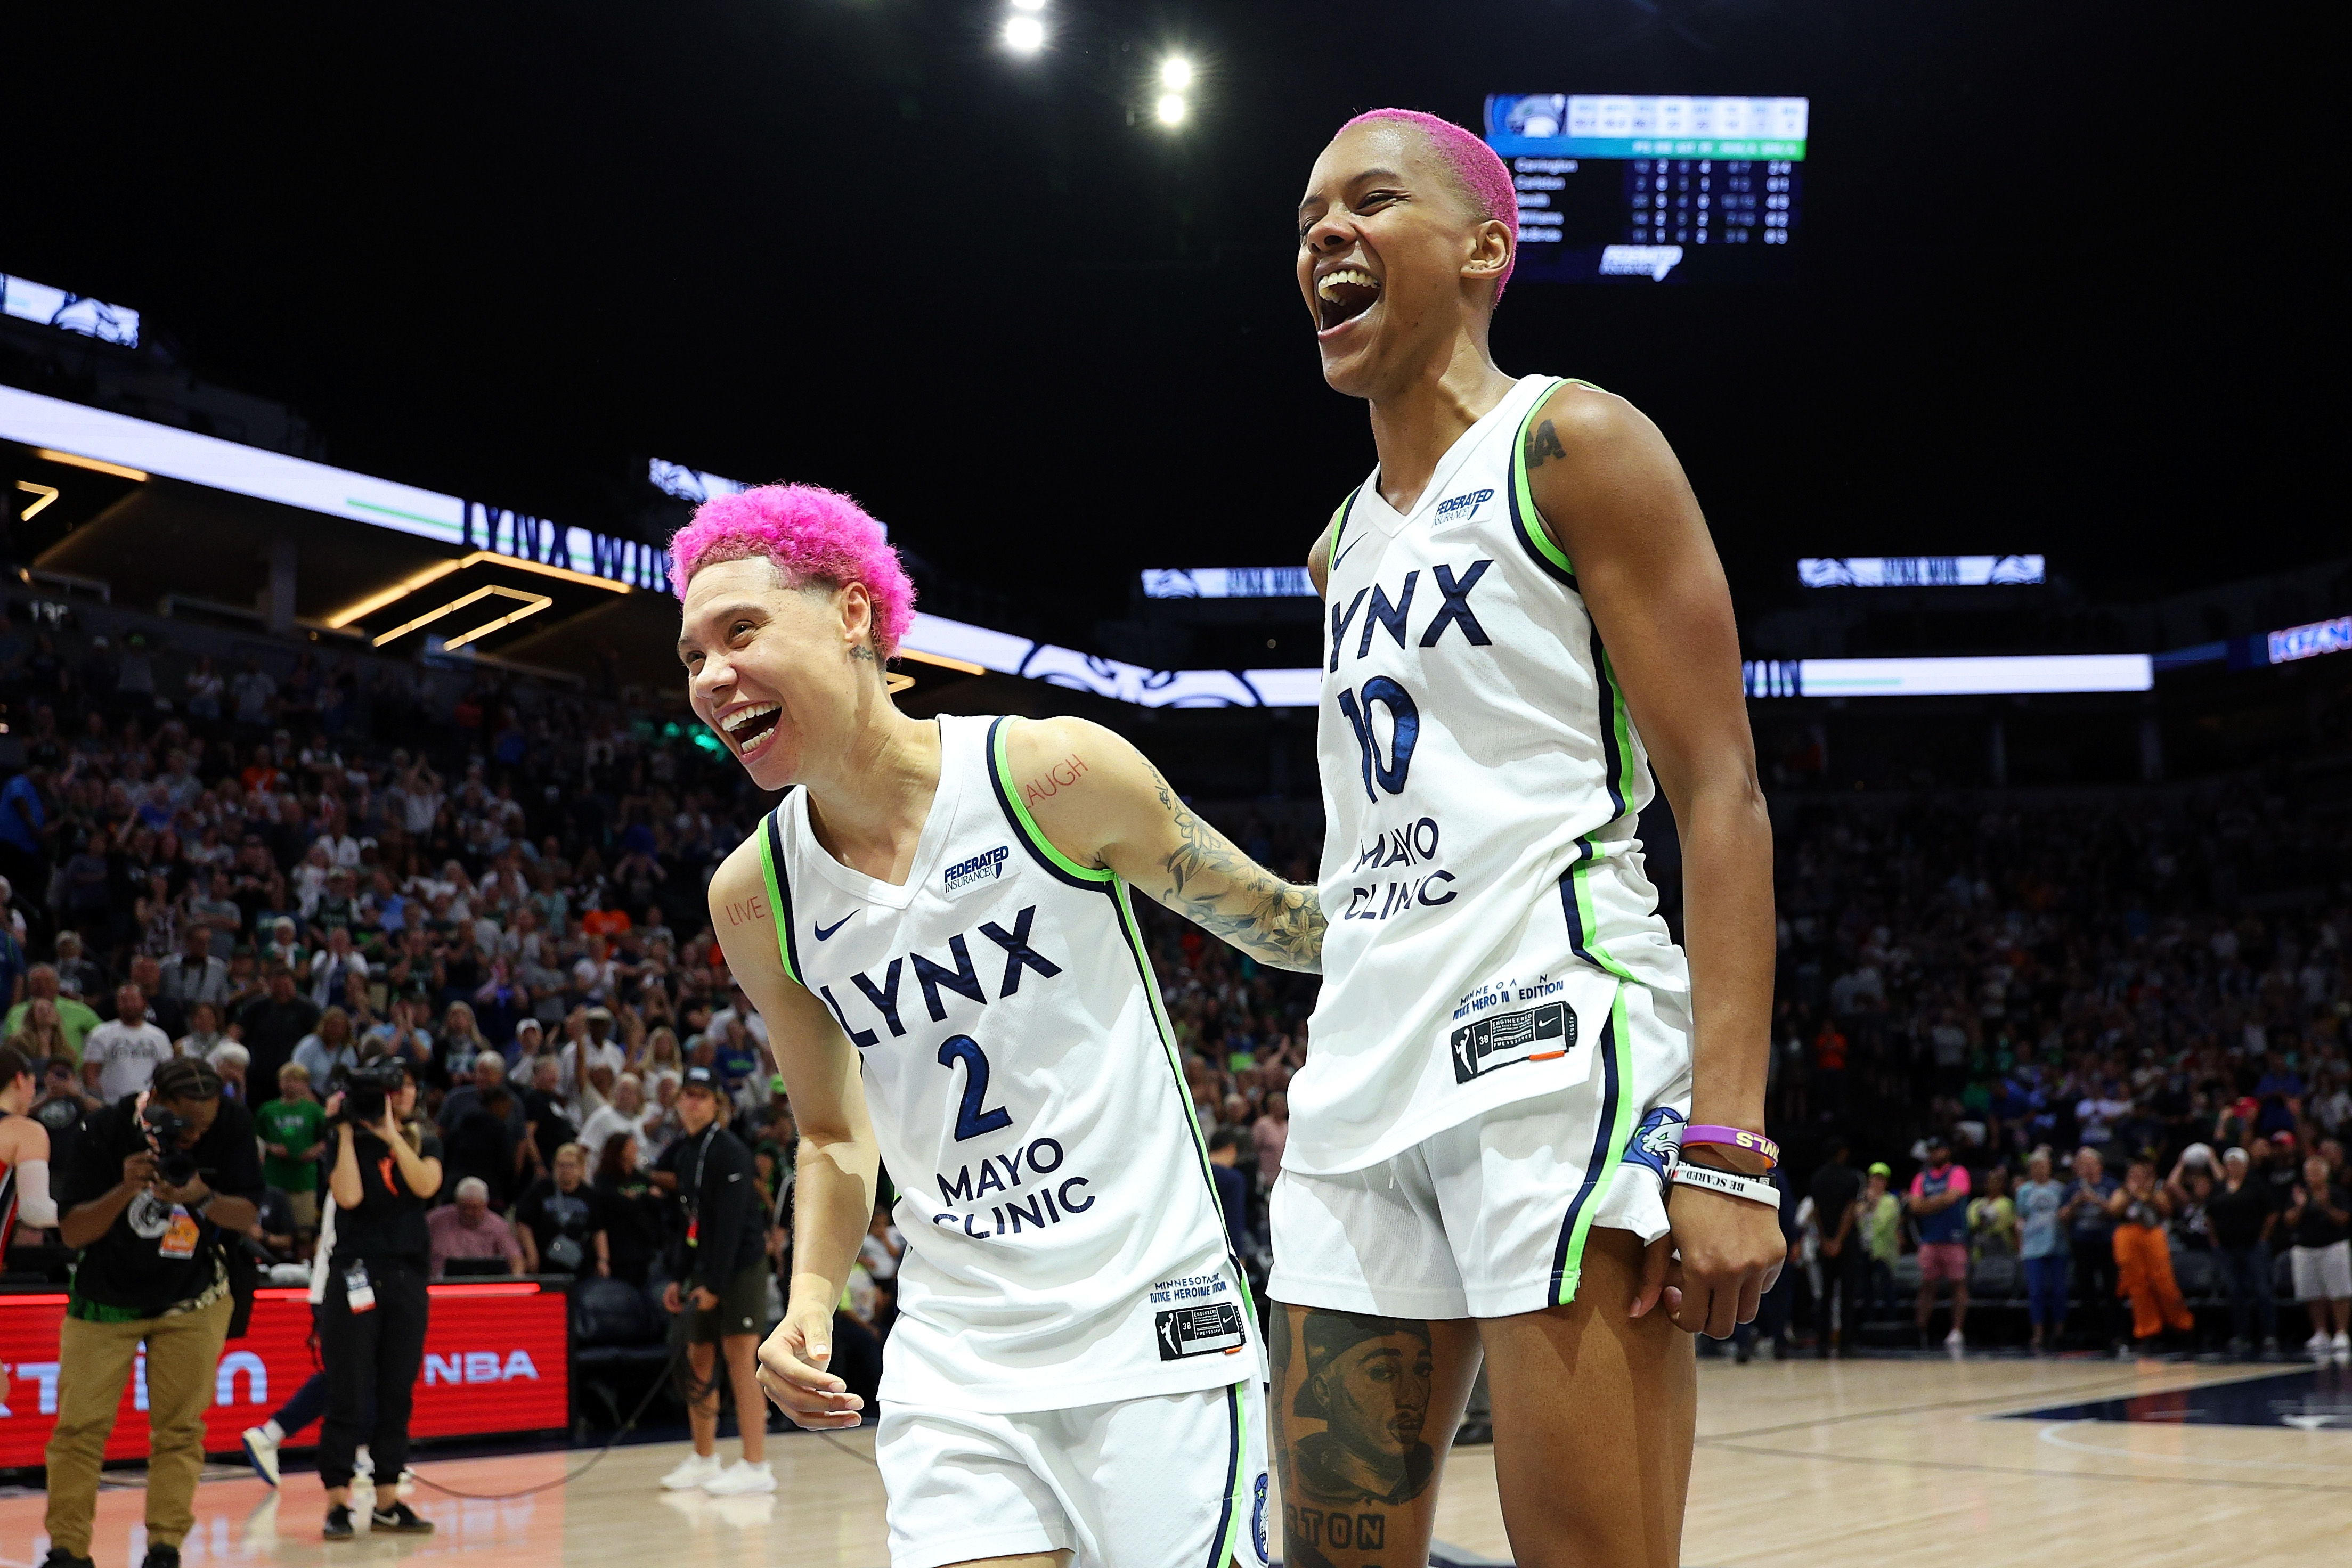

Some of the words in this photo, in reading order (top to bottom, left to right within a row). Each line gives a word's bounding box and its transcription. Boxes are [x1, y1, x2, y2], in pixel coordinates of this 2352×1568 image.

[1435, 489, 1494, 518] FEDERATED
[1321, 559, 1494, 680] YNX
[1337, 675, 1419, 804] 10
[1026, 753, 1089, 810] AUGH
[1352, 816, 1439, 874] MAYO
[945, 846, 1009, 883] FEDERATED
[945, 867, 990, 893] INSURANCE
[1344, 869, 1458, 920] CLINC
[725, 896, 766, 926] LIVE
[820, 905, 1063, 1048] LYNX
[1472, 990, 1510, 1012] HERON
[1519, 980, 1564, 1001] EDITION
[1492, 1013, 1532, 1027] ENGINEERED
[1478, 1034, 1490, 1046] 38
[937, 1034, 1014, 1142] 2
[1735, 1132, 1780, 1162] WLS
[937, 1138, 1063, 1207] MAYO
[1686, 1170, 1728, 1189] SCARED
[1730, 1180, 1745, 1193] BE
[1150, 1291, 1171, 1303] NIKE
[1174, 1286, 1210, 1300] HEROINE
[1155, 1276, 1212, 1291] MINNESOTA
[1182, 1321, 1191, 1330] 38
[424, 1349, 540, 1386] NBA
